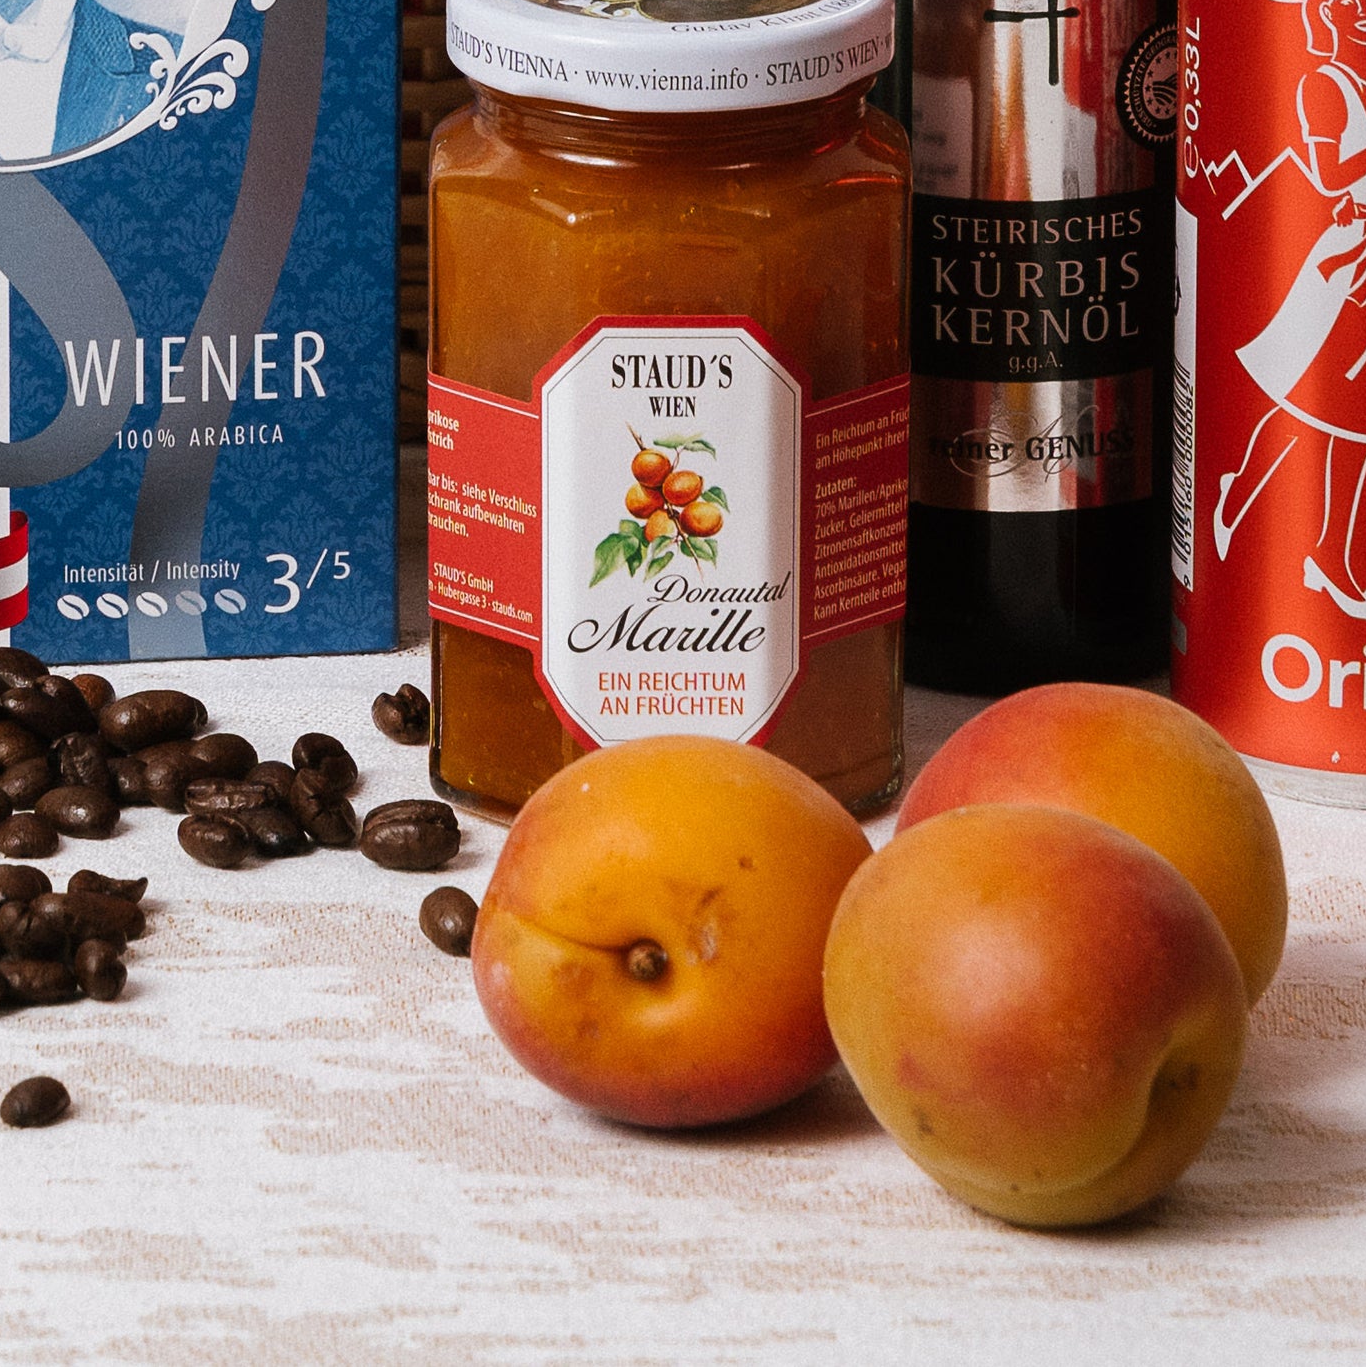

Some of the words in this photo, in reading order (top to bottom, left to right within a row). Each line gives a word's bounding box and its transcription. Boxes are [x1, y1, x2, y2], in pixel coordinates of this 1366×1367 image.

[671, 19, 752, 35] Gustav
[450, 23, 493, 65] STAUD'S
[496, 44, 569, 82] VIENNA
[585, 65, 748, 92] www.vienna.info
[766, 52, 844, 87] STAUD'S
[847, 38, 881, 68] WIEN
[932, 209, 1142, 245] STEIRISCHES
[932, 251, 1140, 299] KÜRBIS
[932, 294, 1139, 346] KERNÖL
[64, 331, 326, 406] WIENER
[1009, 351, 1064, 374] g.g.A.
[648, 396, 697, 418] WIEN
[115, 428, 176, 449] 100%
[189, 424, 284, 447] ARABICA
[428, 425, 454, 451] strich
[815, 433, 831, 450] Ein
[832, 420, 876, 444] Reichtum
[877, 417, 889, 430] an
[815, 454, 831, 470] am
[832, 435, 883, 465] Höhepunkt
[884, 429, 906, 449] ihrer
[441, 472, 458, 494] bis:
[462, 481, 487, 503] siehe
[488, 488, 538, 519] Verschluss
[815, 476, 857, 500] Zutaten:
[463, 503, 525, 535] aufbewahren
[815, 501, 836, 519] 70%
[849, 501, 904, 529] Geliermittel
[64, 562, 144, 584] Intensität
[167, 559, 240, 580] Intensity
[467, 573, 494, 594] GmbH
[814, 571, 880, 601] Ascorbinsäure.
[438, 582, 481, 609] Hubergasse
[481, 594, 487, 609] 3
[491, 599, 533, 624] stauds.com
[647, 571, 791, 605] Donautal
[813, 603, 837, 621] Kann
[838, 588, 880, 613] Kernteile
[567, 603, 766, 654] Marille
[598, 672, 632, 692] EIN
[639, 671, 746, 692] REICHTUM
[600, 697, 630, 716] AN
[636, 689, 745, 716] FRÜCHTEN
